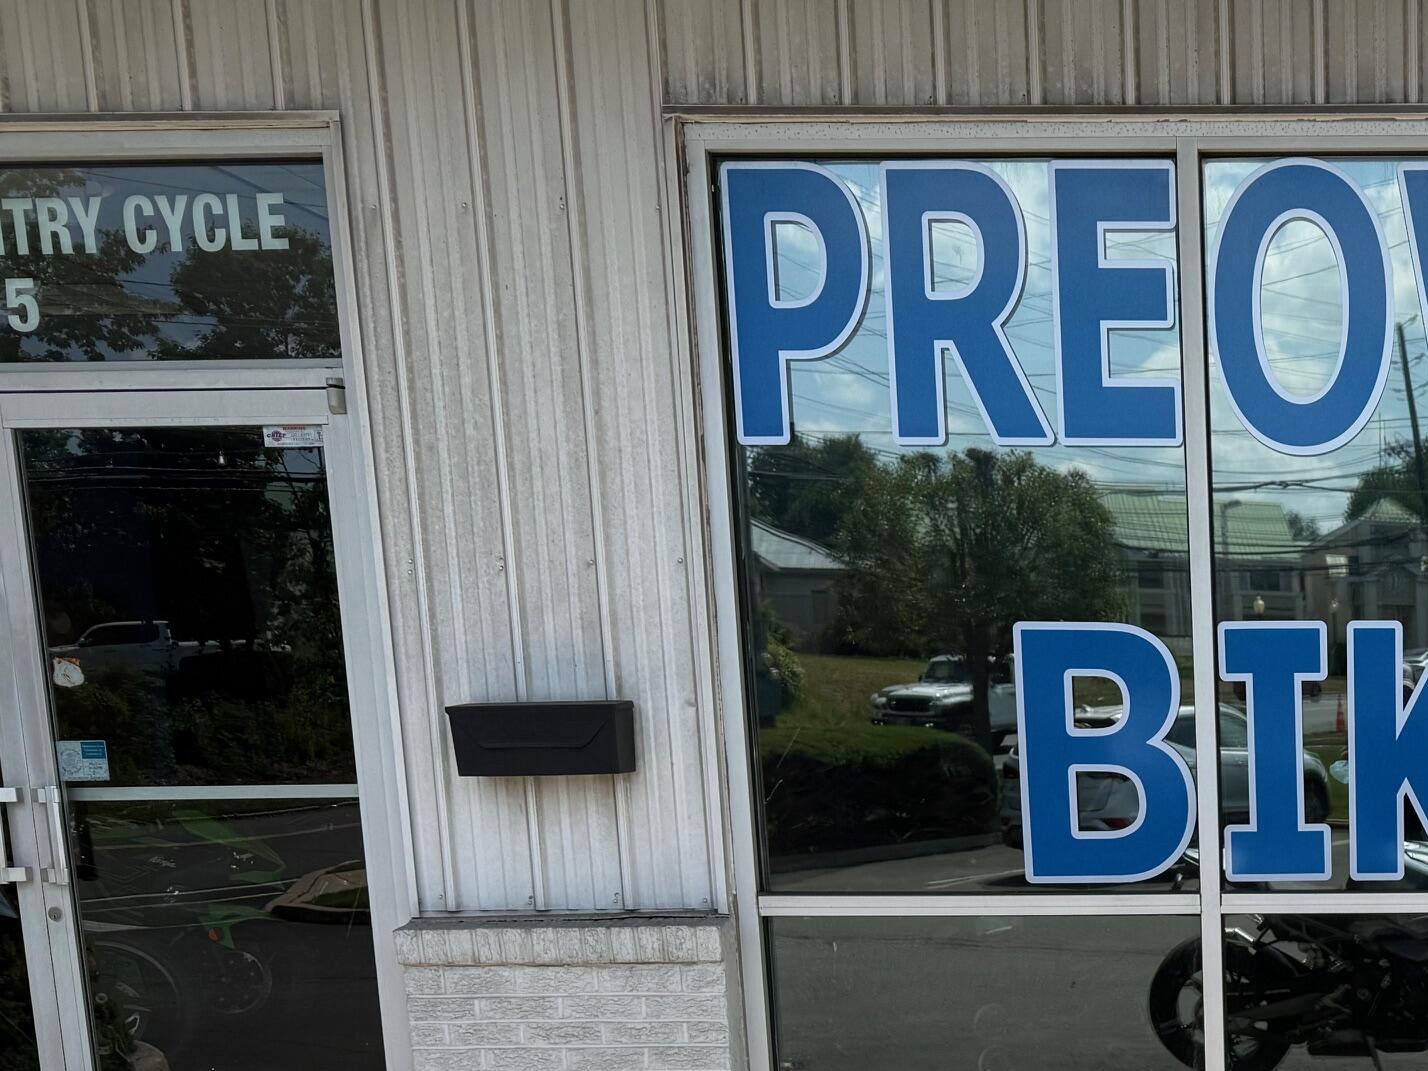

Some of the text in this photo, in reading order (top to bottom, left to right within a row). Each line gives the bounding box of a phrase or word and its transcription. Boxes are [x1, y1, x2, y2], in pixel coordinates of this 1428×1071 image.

[0, 192, 290, 256] TRY CYCLE
[5, 277, 41, 332] 5
